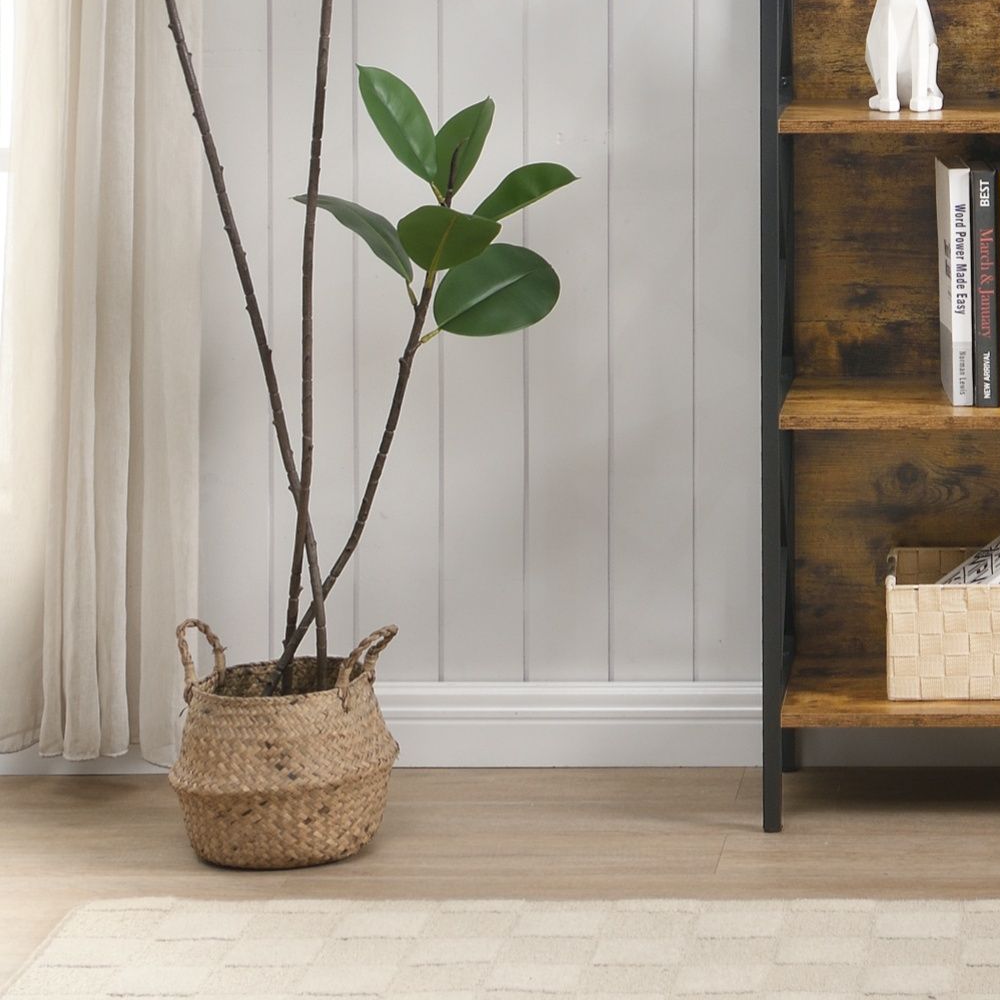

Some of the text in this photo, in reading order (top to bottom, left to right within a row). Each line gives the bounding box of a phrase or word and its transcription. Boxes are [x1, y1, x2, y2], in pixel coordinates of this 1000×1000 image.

[979, 179, 990, 207] BEST
[955, 203, 968, 315] Word Power Made Easy
[980, 228, 994, 271] March
[979, 287, 994, 338] January
[983, 351, 991, 399] NEW ARRIVAL
